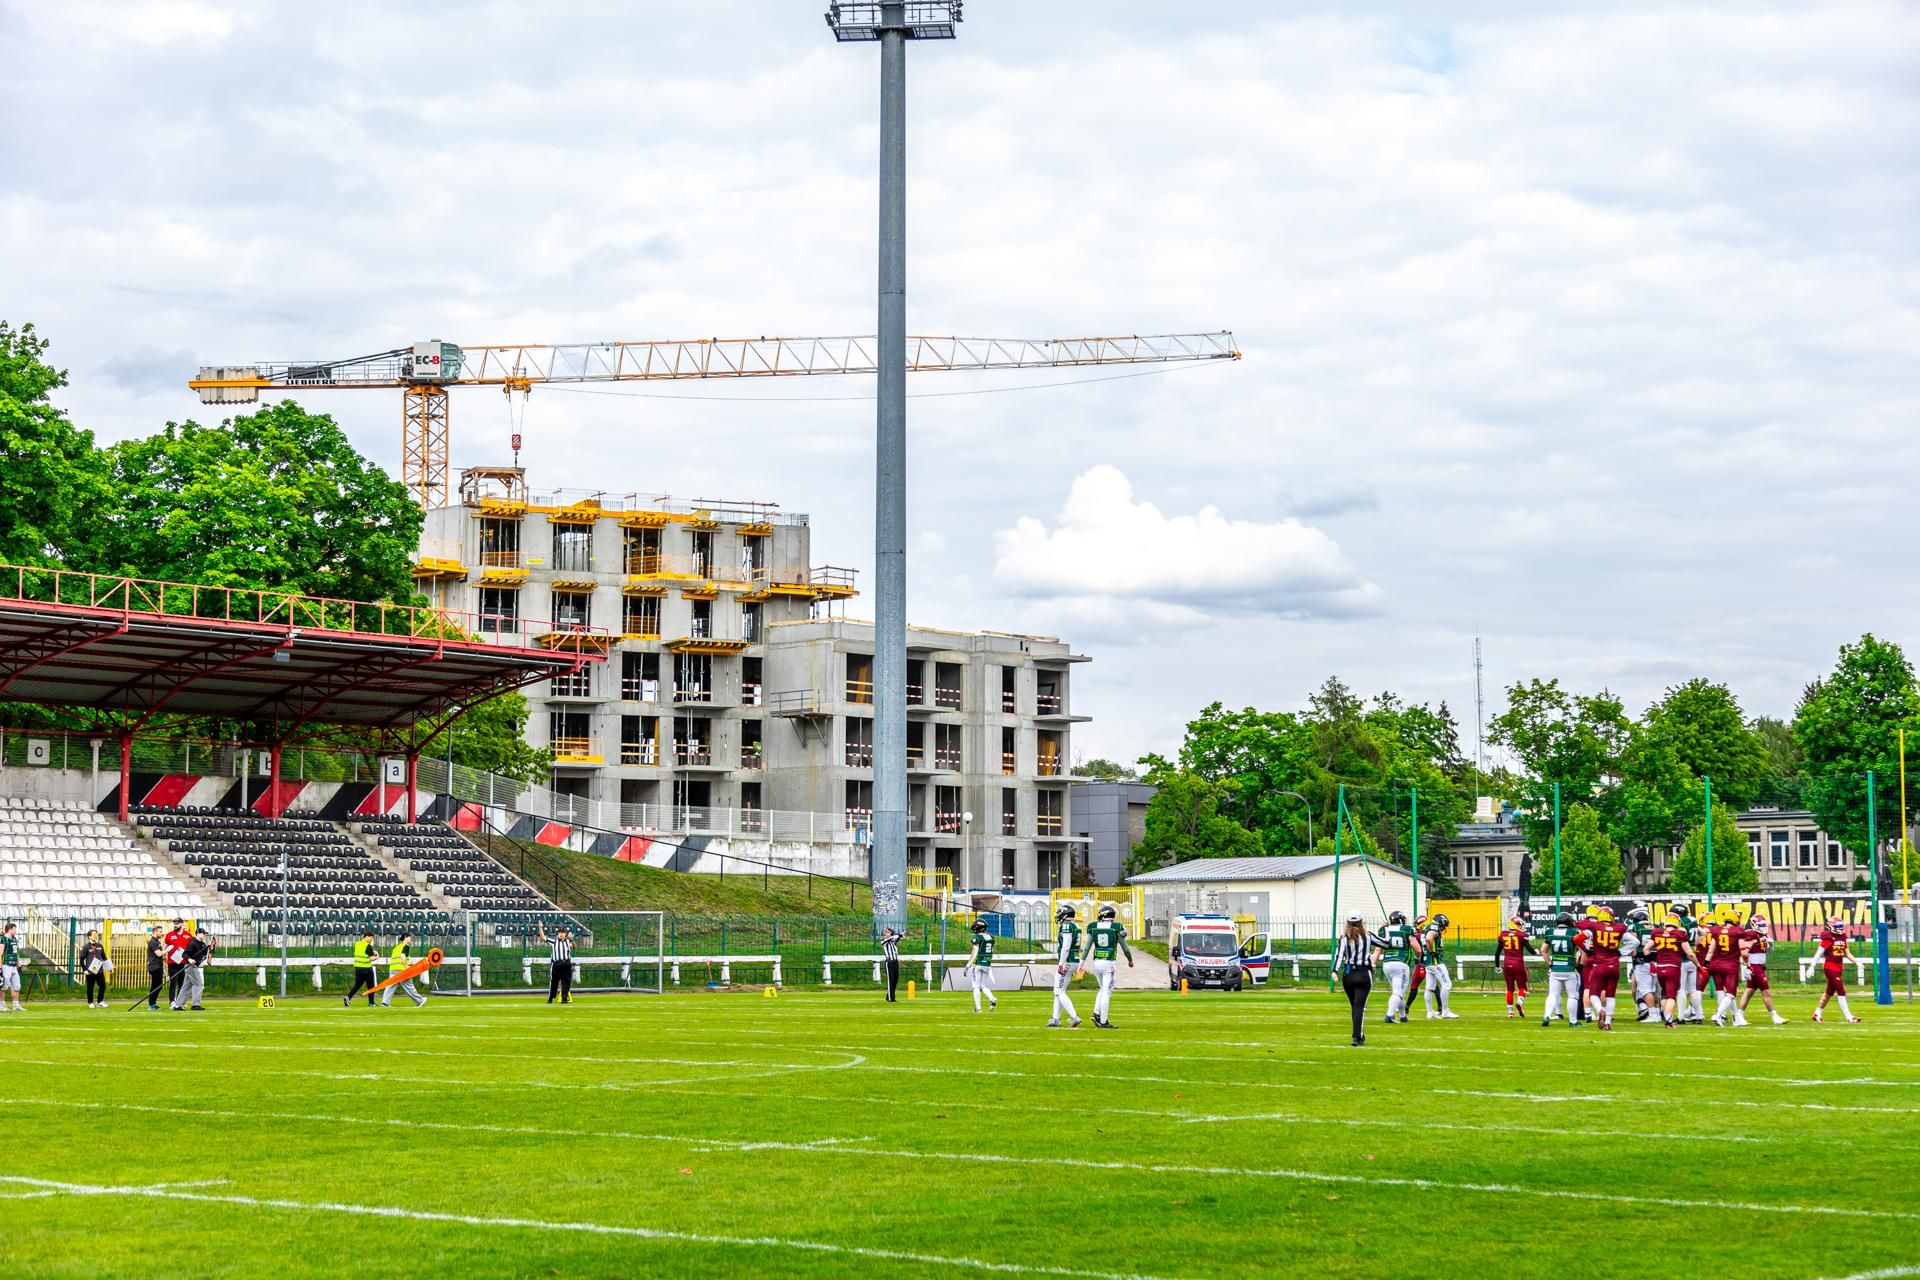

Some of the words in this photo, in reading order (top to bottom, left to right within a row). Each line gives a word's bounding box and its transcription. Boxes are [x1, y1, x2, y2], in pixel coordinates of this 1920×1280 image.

[416, 355, 440, 365] EC-B
[392, 766, 400, 776] a
[1503, 936, 1520, 950] 31
[1596, 930, 1620, 949] 45
[1719, 934, 1729, 951] 9
[1551, 940, 1568, 953] 71
[262, 998, 274, 1008] 20
